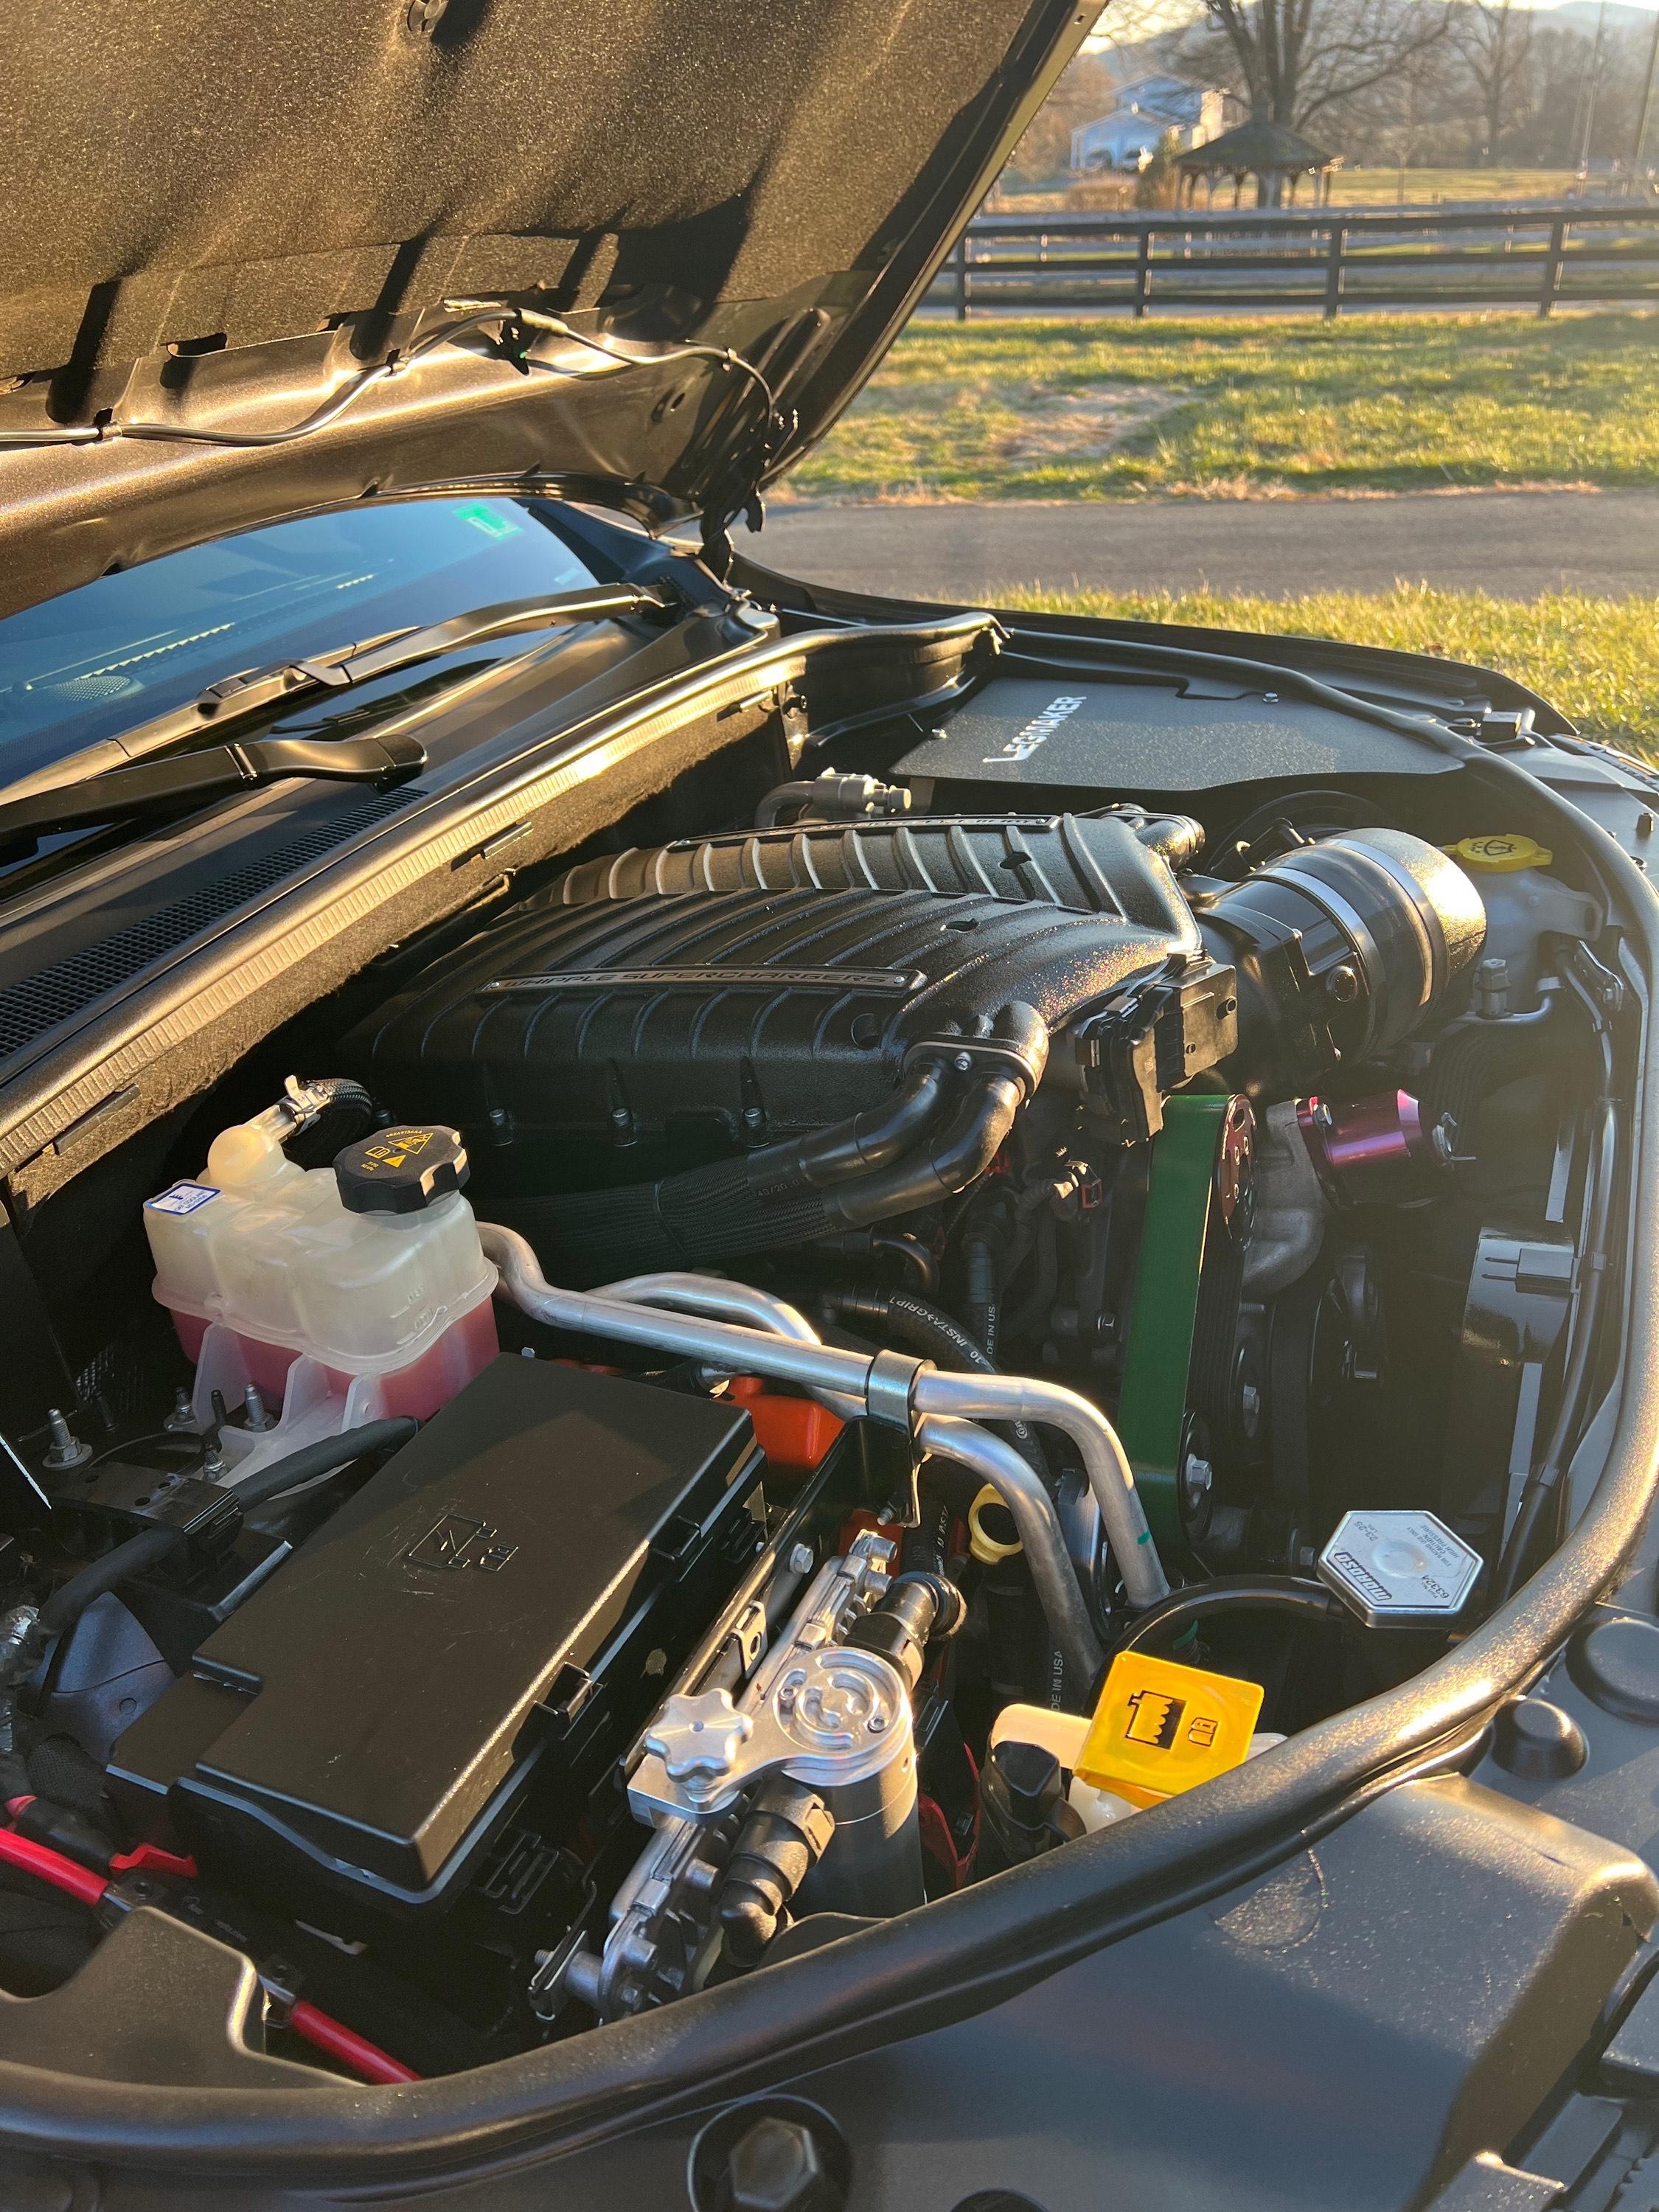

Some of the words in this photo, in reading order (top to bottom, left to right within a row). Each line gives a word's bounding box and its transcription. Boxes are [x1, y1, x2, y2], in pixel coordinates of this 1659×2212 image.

[982, 696, 1088, 763] LEGMAKER
[504, 974, 618, 988] WHIPPLE
[619, 970, 889, 984] SUPERCHARGERS
[987, 1324, 995, 1337] IN
[970, 1350, 983, 1363] 10
[1354, 1521, 1378, 1541] 23-25
[1334, 1551, 1393, 1601] MOROSO
[1053, 1650, 1063, 1676] USA
[1052, 1678, 1062, 1691] IN
[1051, 1694, 1061, 1711] DE
